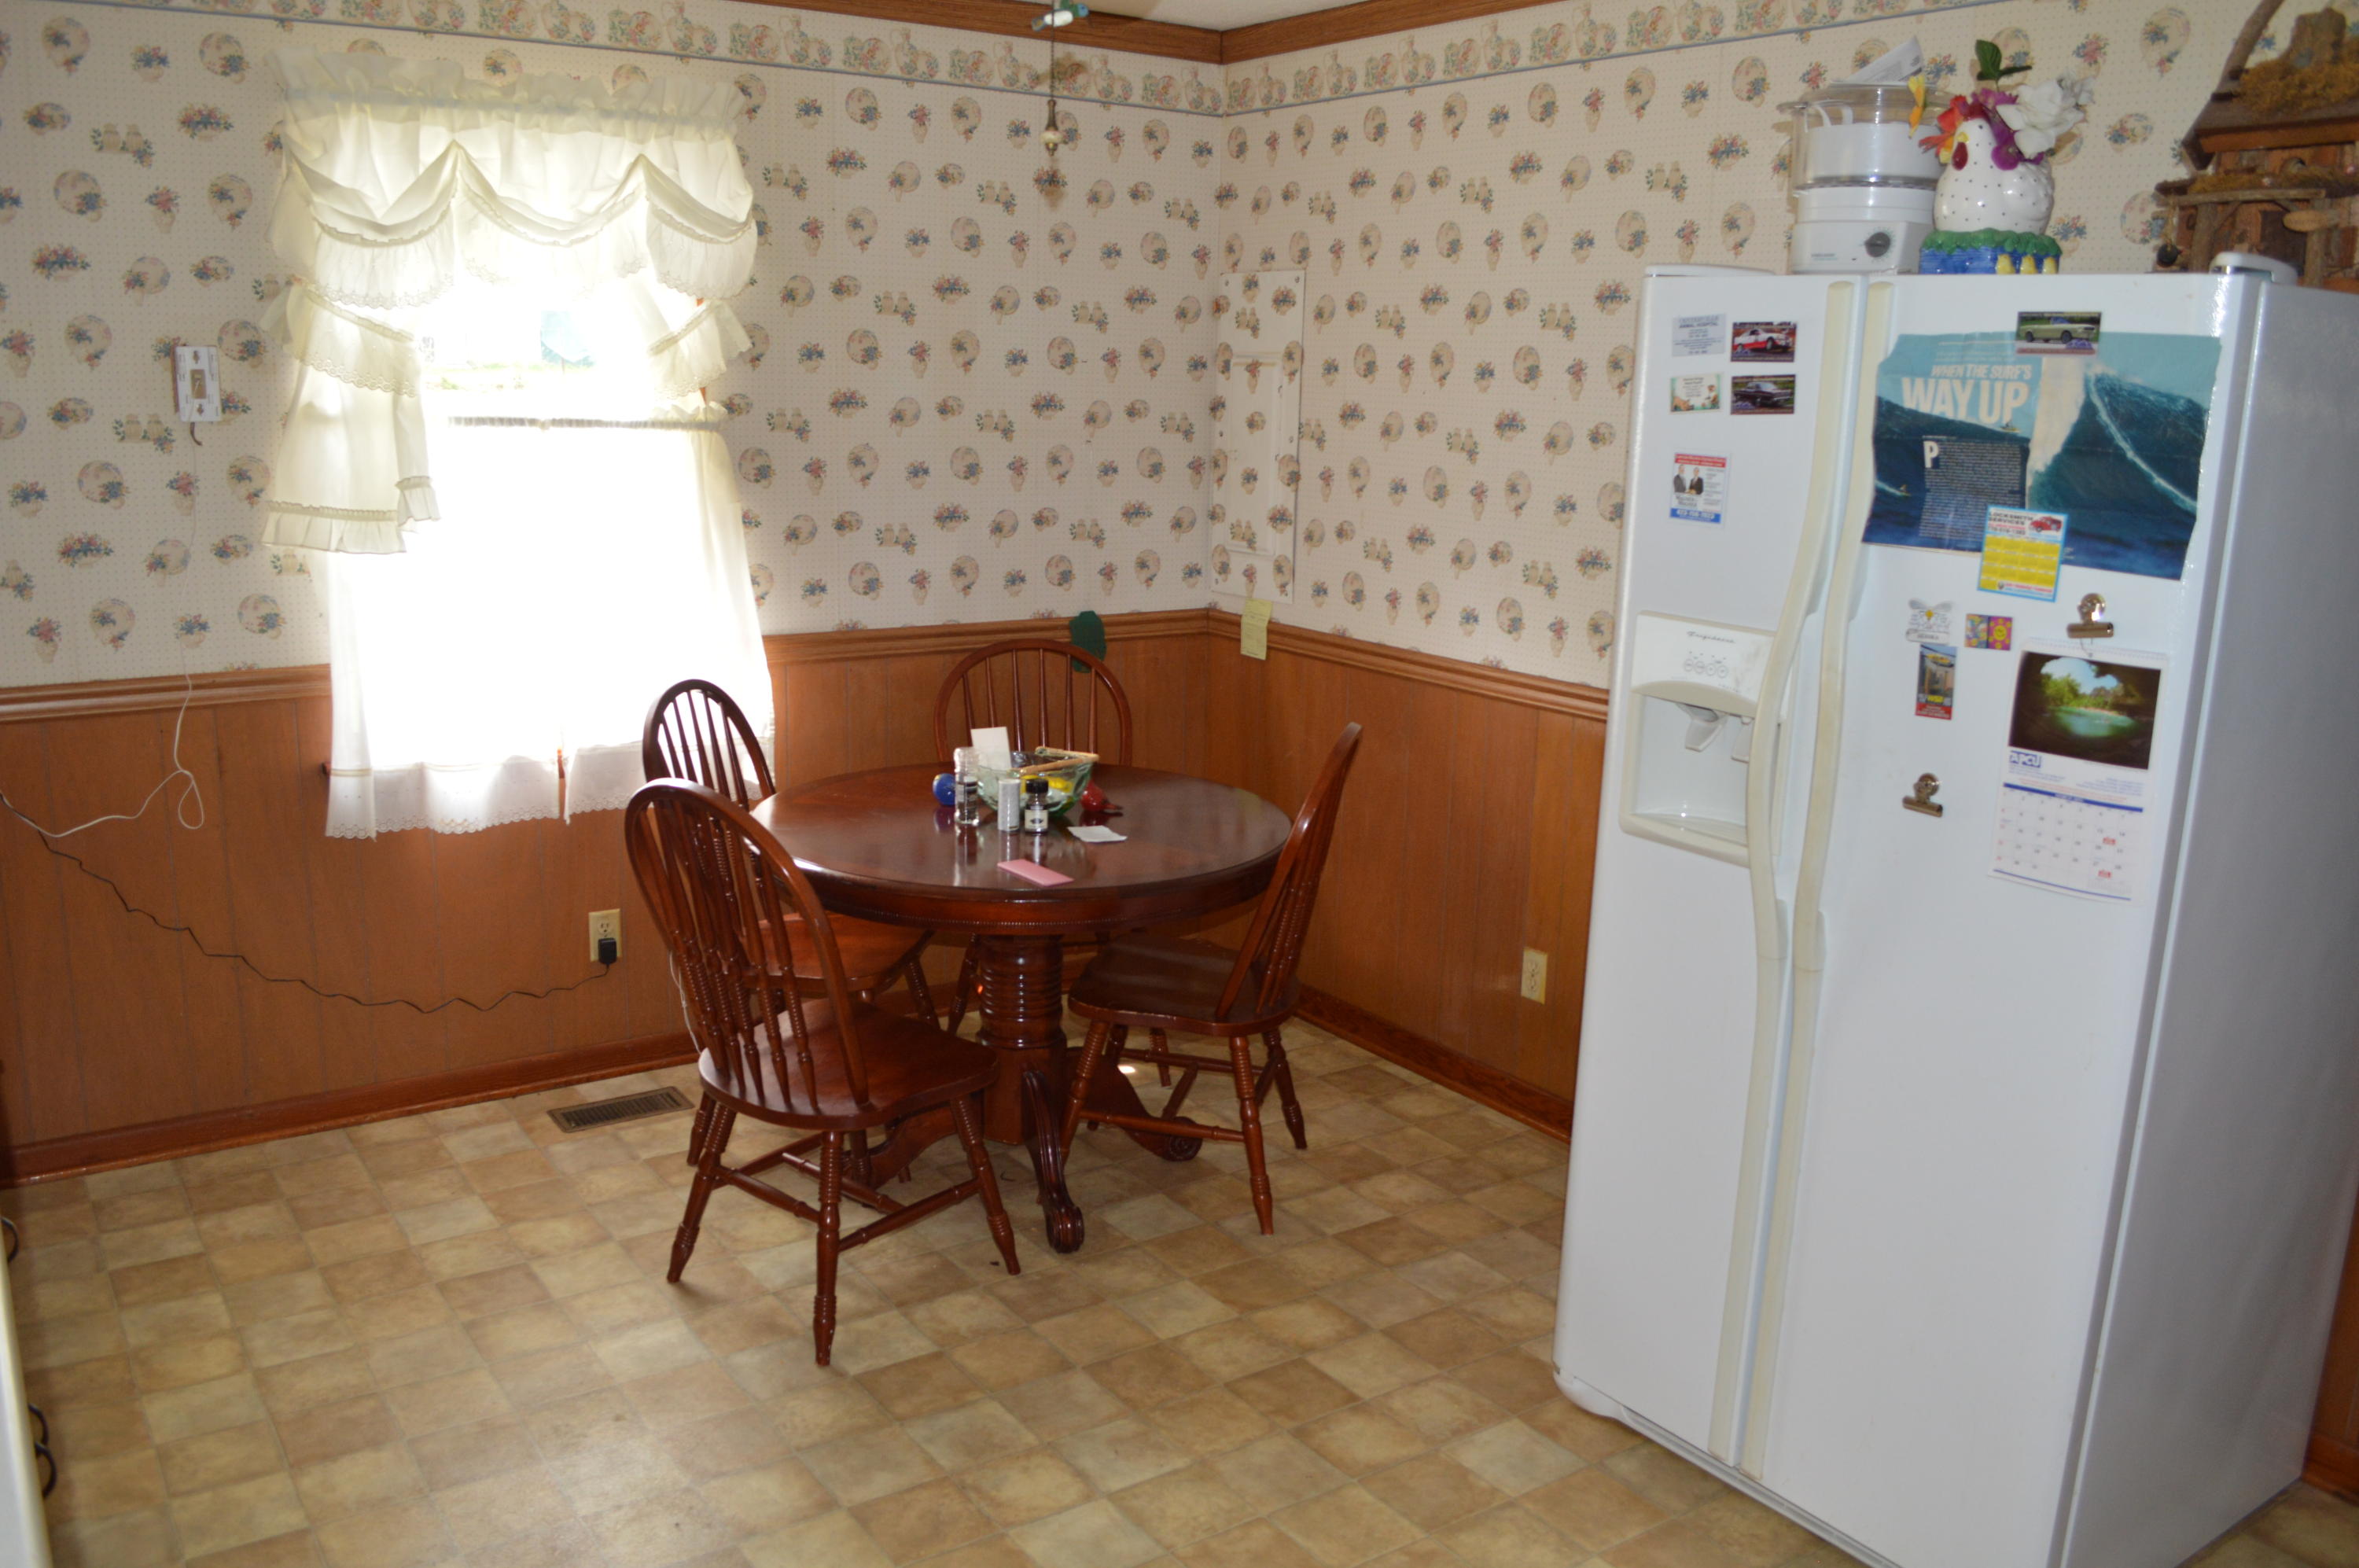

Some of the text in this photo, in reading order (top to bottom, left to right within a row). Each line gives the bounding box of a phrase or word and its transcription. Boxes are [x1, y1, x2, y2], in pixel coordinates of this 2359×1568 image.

[1931, 363, 2033, 380] WHEN THE SURF'S
[1901, 377, 2030, 425] WAY UP
[1923, 440, 1939, 468] P
